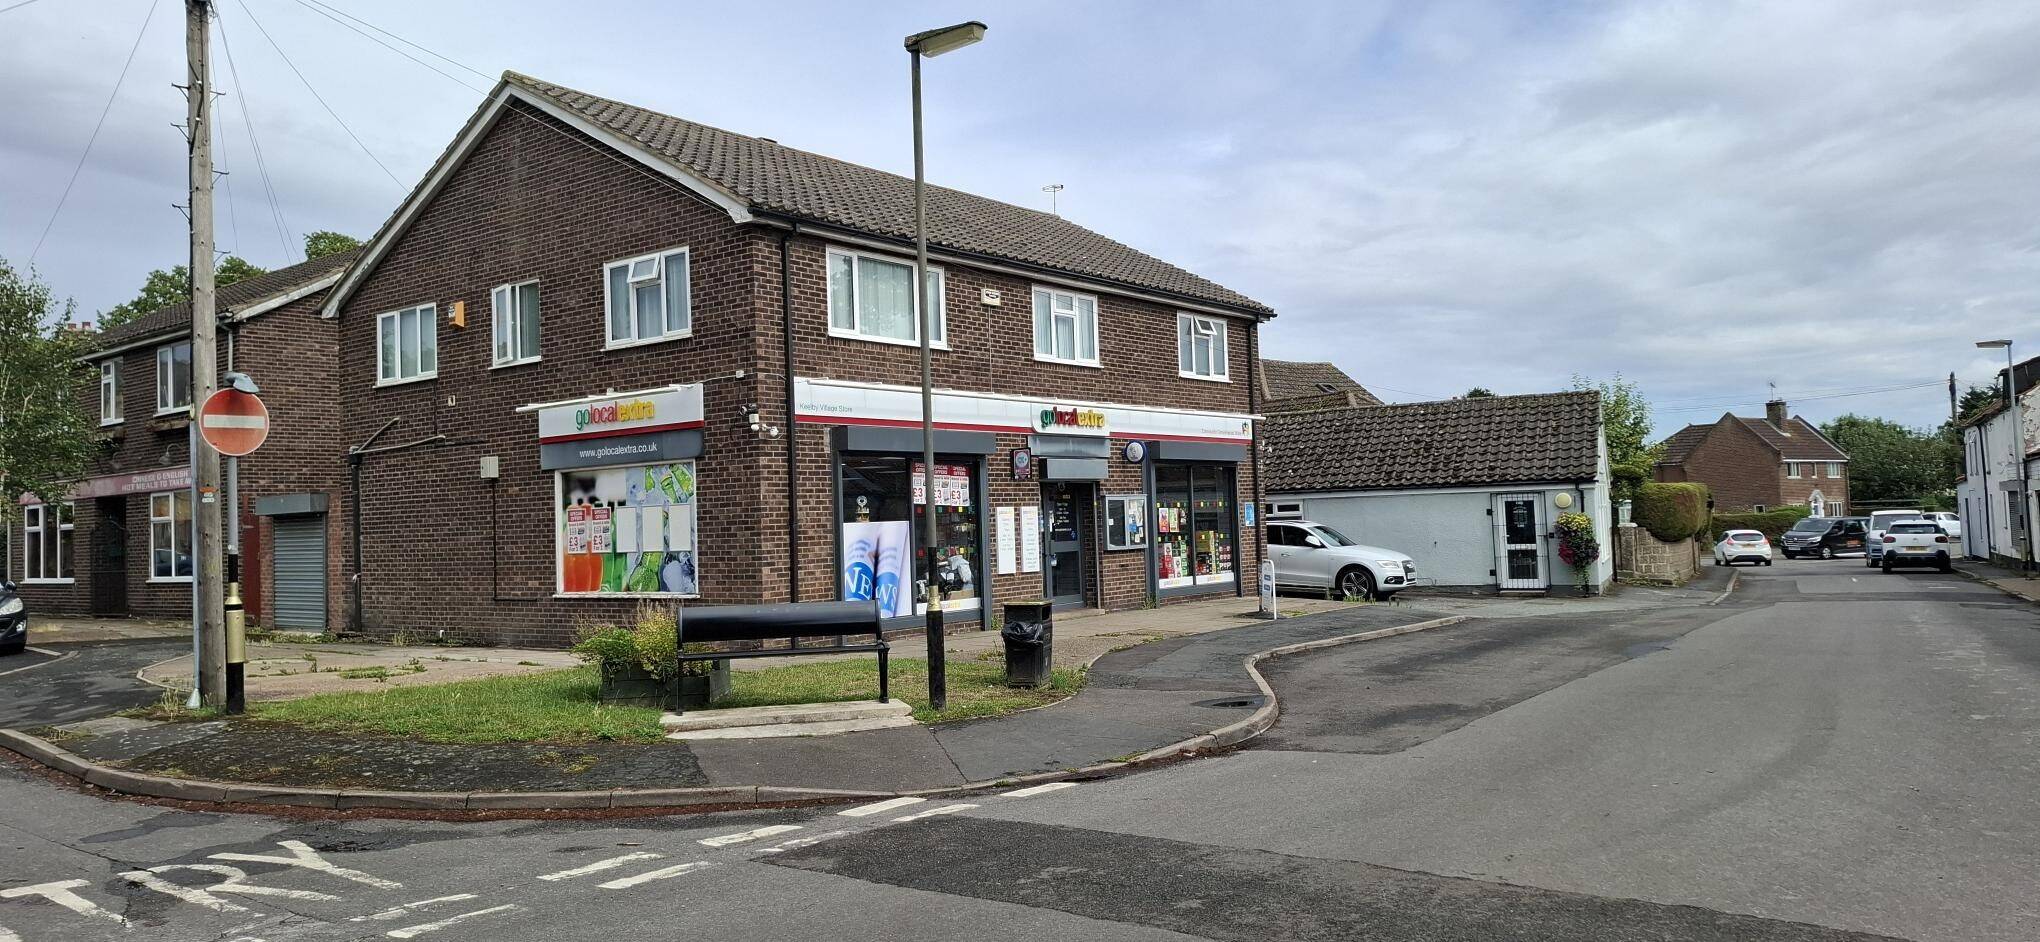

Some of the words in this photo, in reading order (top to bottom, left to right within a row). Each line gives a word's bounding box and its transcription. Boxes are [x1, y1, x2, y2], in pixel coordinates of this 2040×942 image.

[819, 403, 838, 412] Village
[838, 404, 853, 413] Store
[576, 400, 655, 431] golocalextra
[1040, 406, 1105, 429] golocalextra
[579, 442, 658, 459] www.golocalextra.co.uk
[162, 470, 189, 480] ENGLISH
[121, 483, 135, 491] HOT
[136, 481, 159, 490] MEALS
[159, 479, 168, 487] TO
[169, 478, 184, 486] TAKE
[569, 536, 579, 547] £3
[593, 535, 603, 545] £3
[0, 839, 403, 929] TRY
